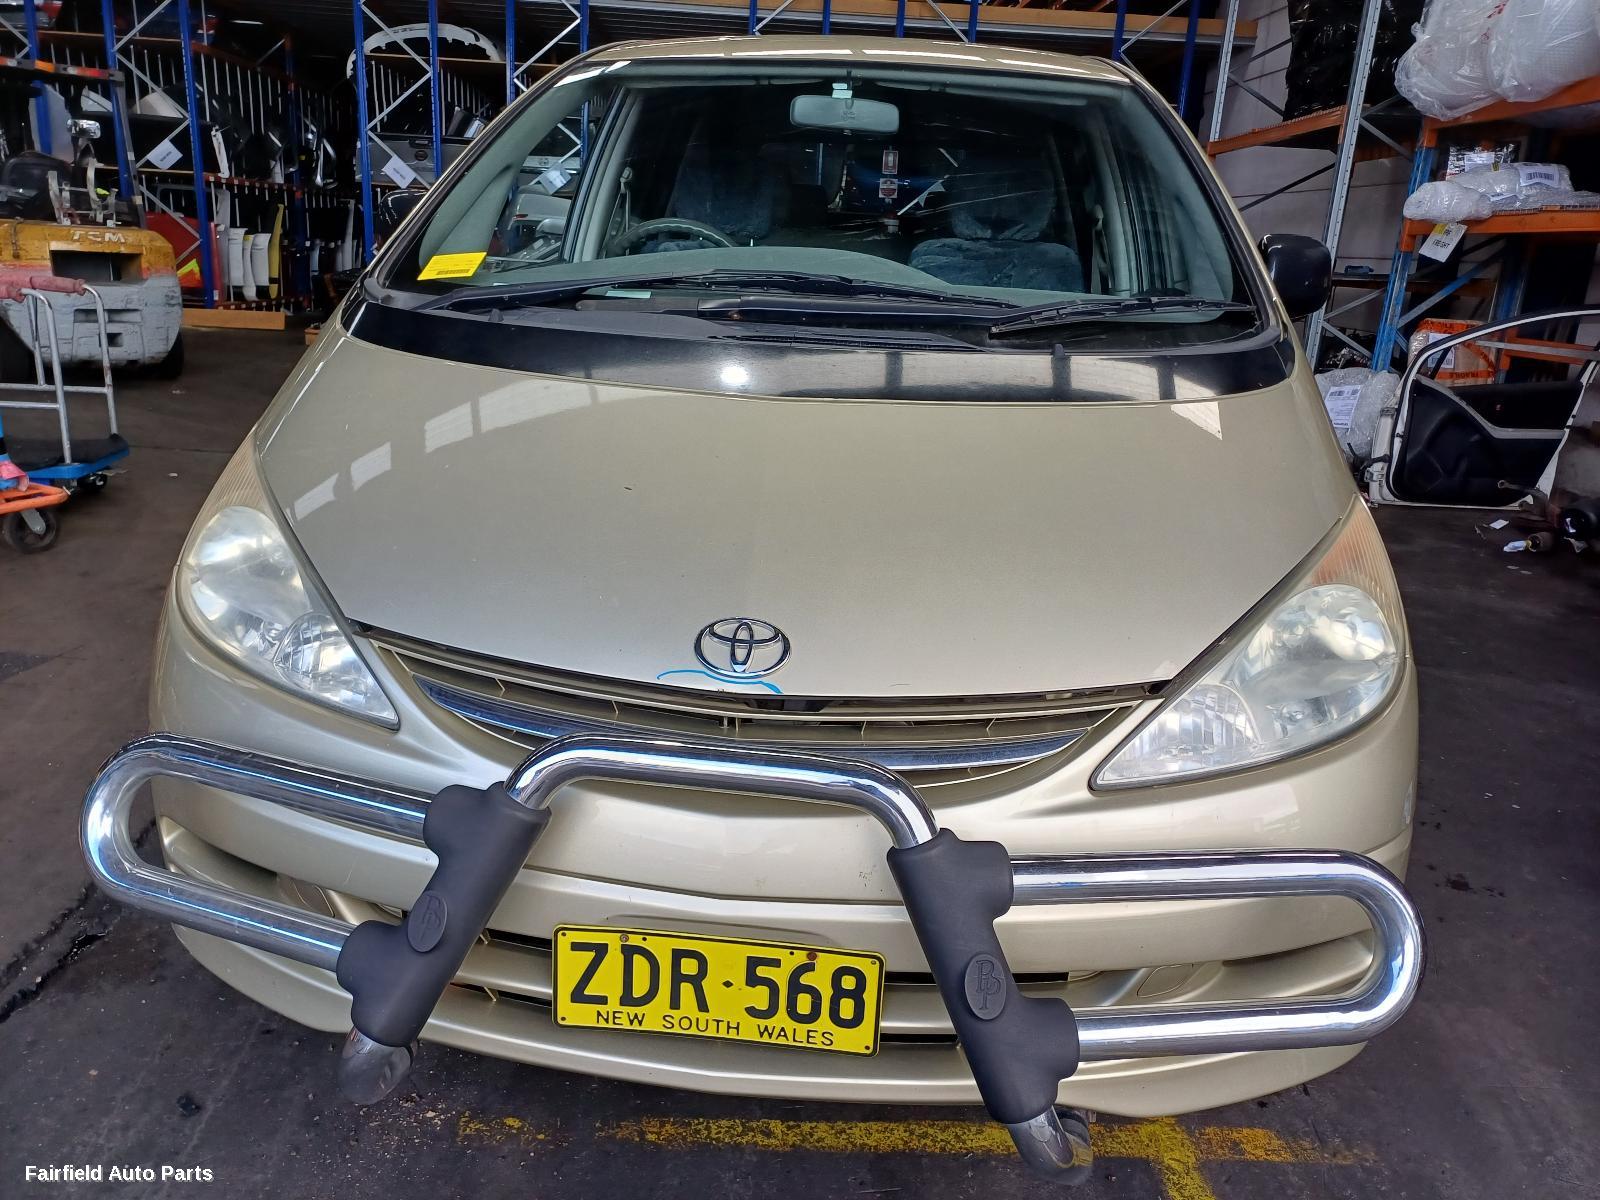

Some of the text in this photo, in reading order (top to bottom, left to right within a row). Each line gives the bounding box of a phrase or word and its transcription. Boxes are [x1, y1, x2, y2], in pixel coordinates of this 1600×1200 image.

[71, 230, 125, 243] TCM
[596, 1010, 834, 1047] NEW SOUTH WALES
